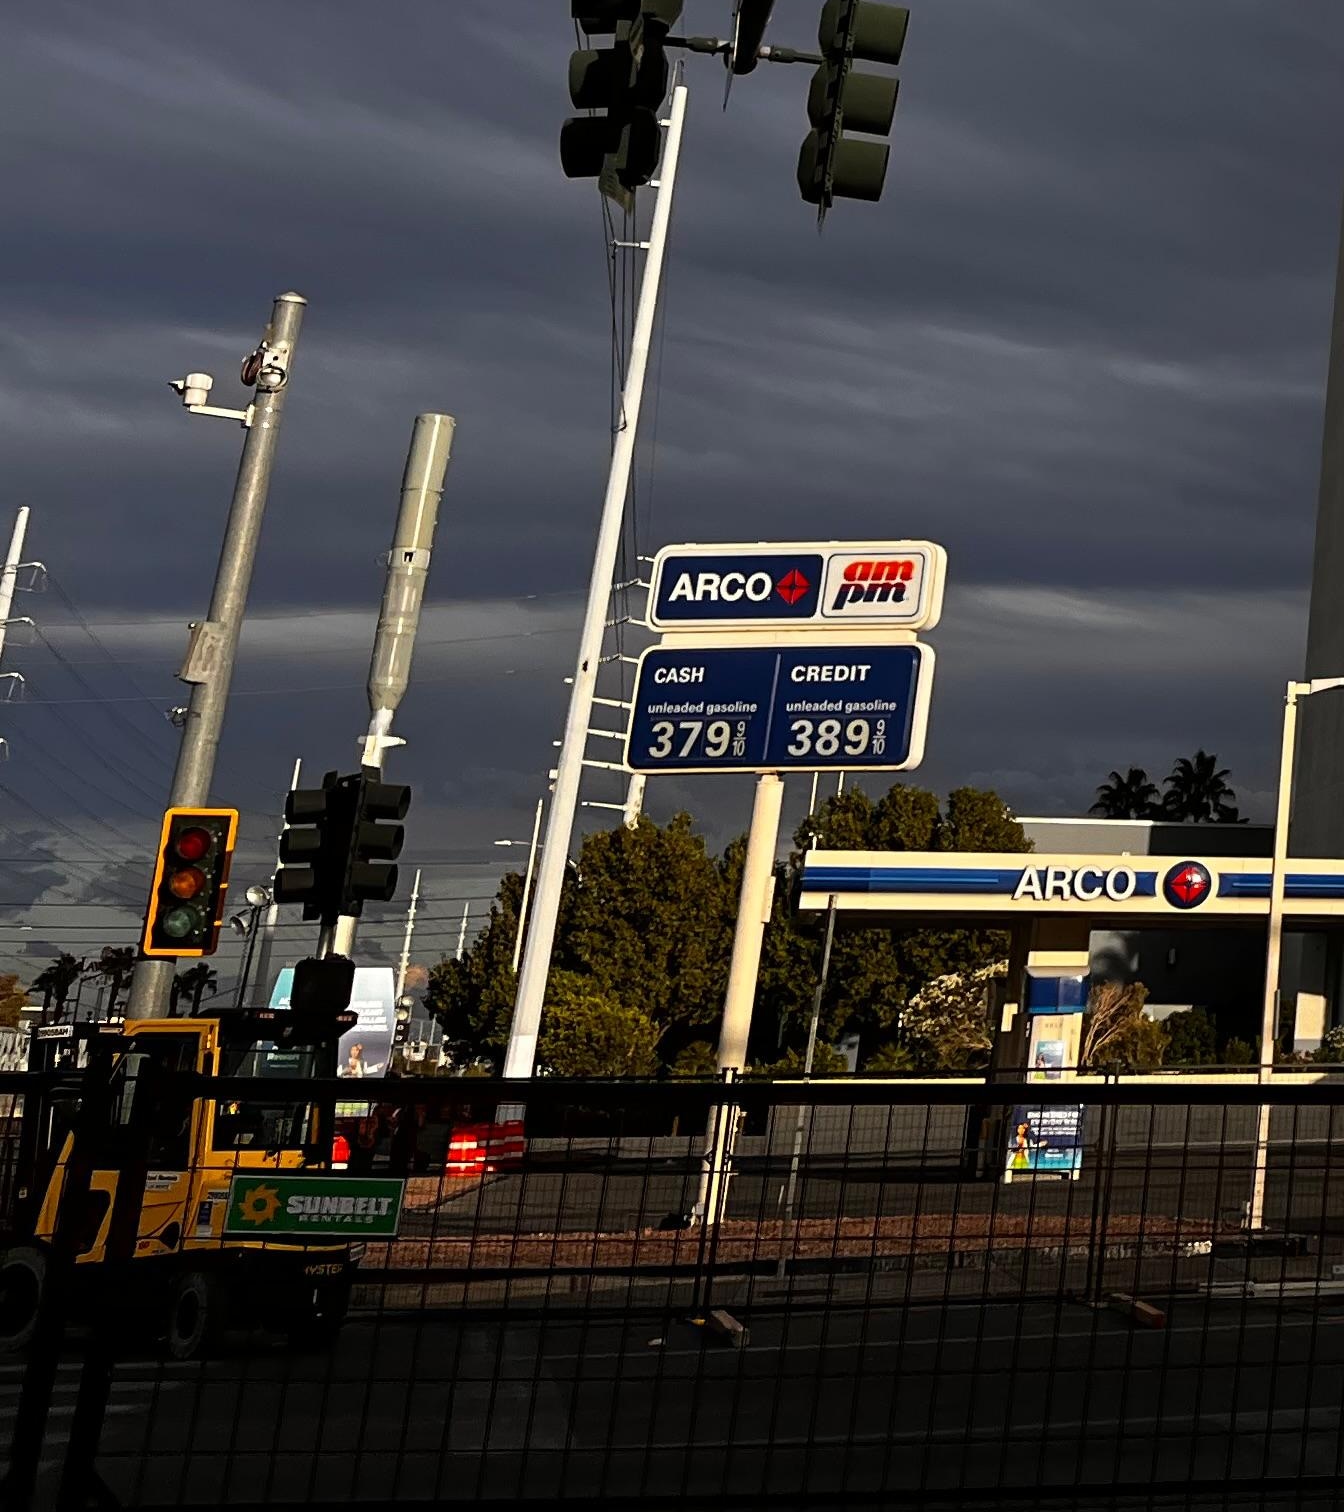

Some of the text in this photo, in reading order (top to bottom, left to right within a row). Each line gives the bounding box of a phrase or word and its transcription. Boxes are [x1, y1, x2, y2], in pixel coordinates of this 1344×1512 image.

[843, 560, 915, 583] am
[668, 572, 773, 602] ARCO
[831, 582, 907, 610] pm
[654, 666, 705, 683] CASH
[790, 664, 871, 682] CREDIT
[647, 701, 758, 716] unleaded gasoline
[786, 700, 897, 714] unleaded gasoline
[648, 720, 731, 758] 379
[787, 719, 870, 757] 389
[1012, 864, 1137, 902] ARCO
[286, 1196, 393, 1216] SUNBELT
[299, 1215, 374, 1224] RENTALS
